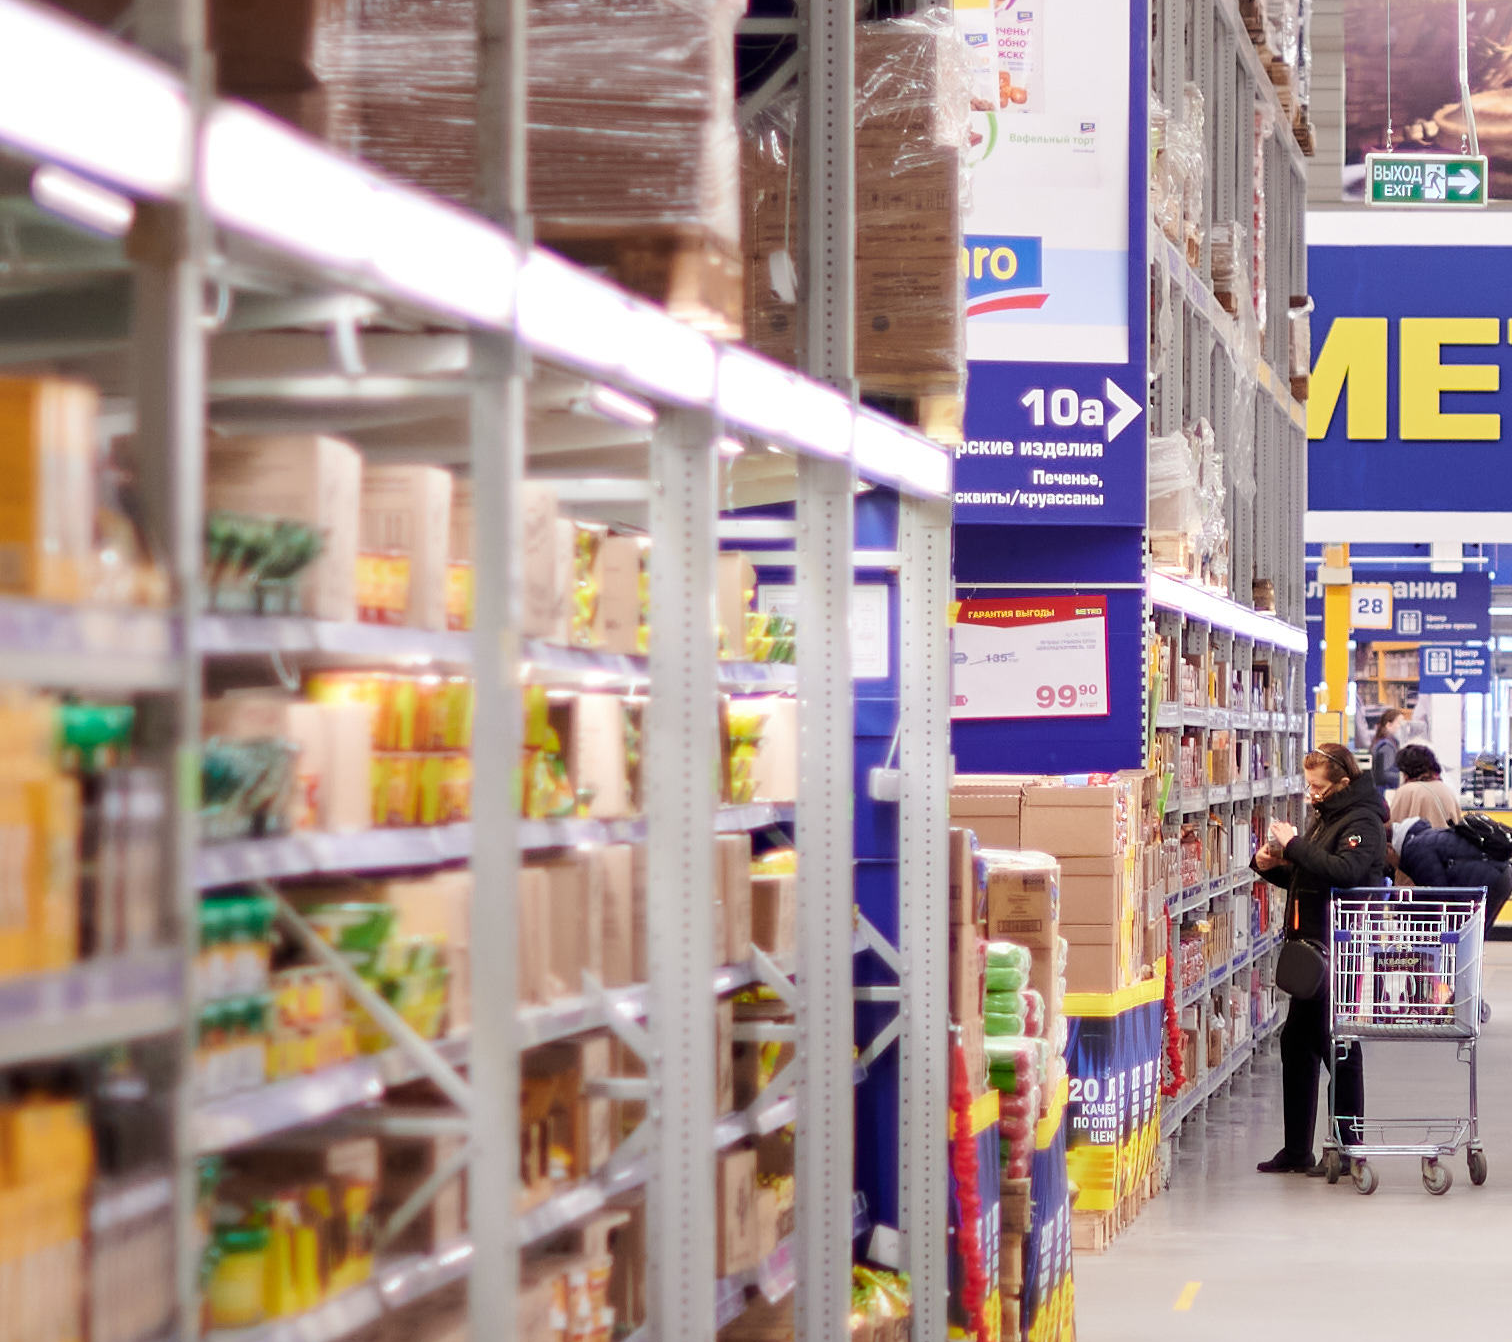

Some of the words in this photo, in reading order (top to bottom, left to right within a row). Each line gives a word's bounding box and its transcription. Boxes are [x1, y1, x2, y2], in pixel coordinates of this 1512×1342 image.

[1009, 133, 1070, 144] Вафельный
[1073, 137, 1095, 146] торт
[1373, 165, 1423, 184] ВЫХОД
[1384, 184, 1414, 197] EXIT
[1021, 389, 1104, 426] 10а
[955, 439, 1014, 459] рские
[1020, 441, 1104, 459] изделия
[1033, 469, 1104, 488] Печенье,
[955, 489, 1104, 508] сквиты/круассаны
[967, 610, 1014, 619] ГАРАНТИЯ
[1015, 608, 1055, 618] ВЫГОДЫ
[1358, 598, 1383, 614] 28
[1036, 685, 1078, 709] 99
[1079, 684, 1098, 695] 90
[1069, 1078, 1099, 1102] 20
[1073, 1117, 1089, 1128] ПО
[1090, 1130, 1116, 1143] ЦЕН
